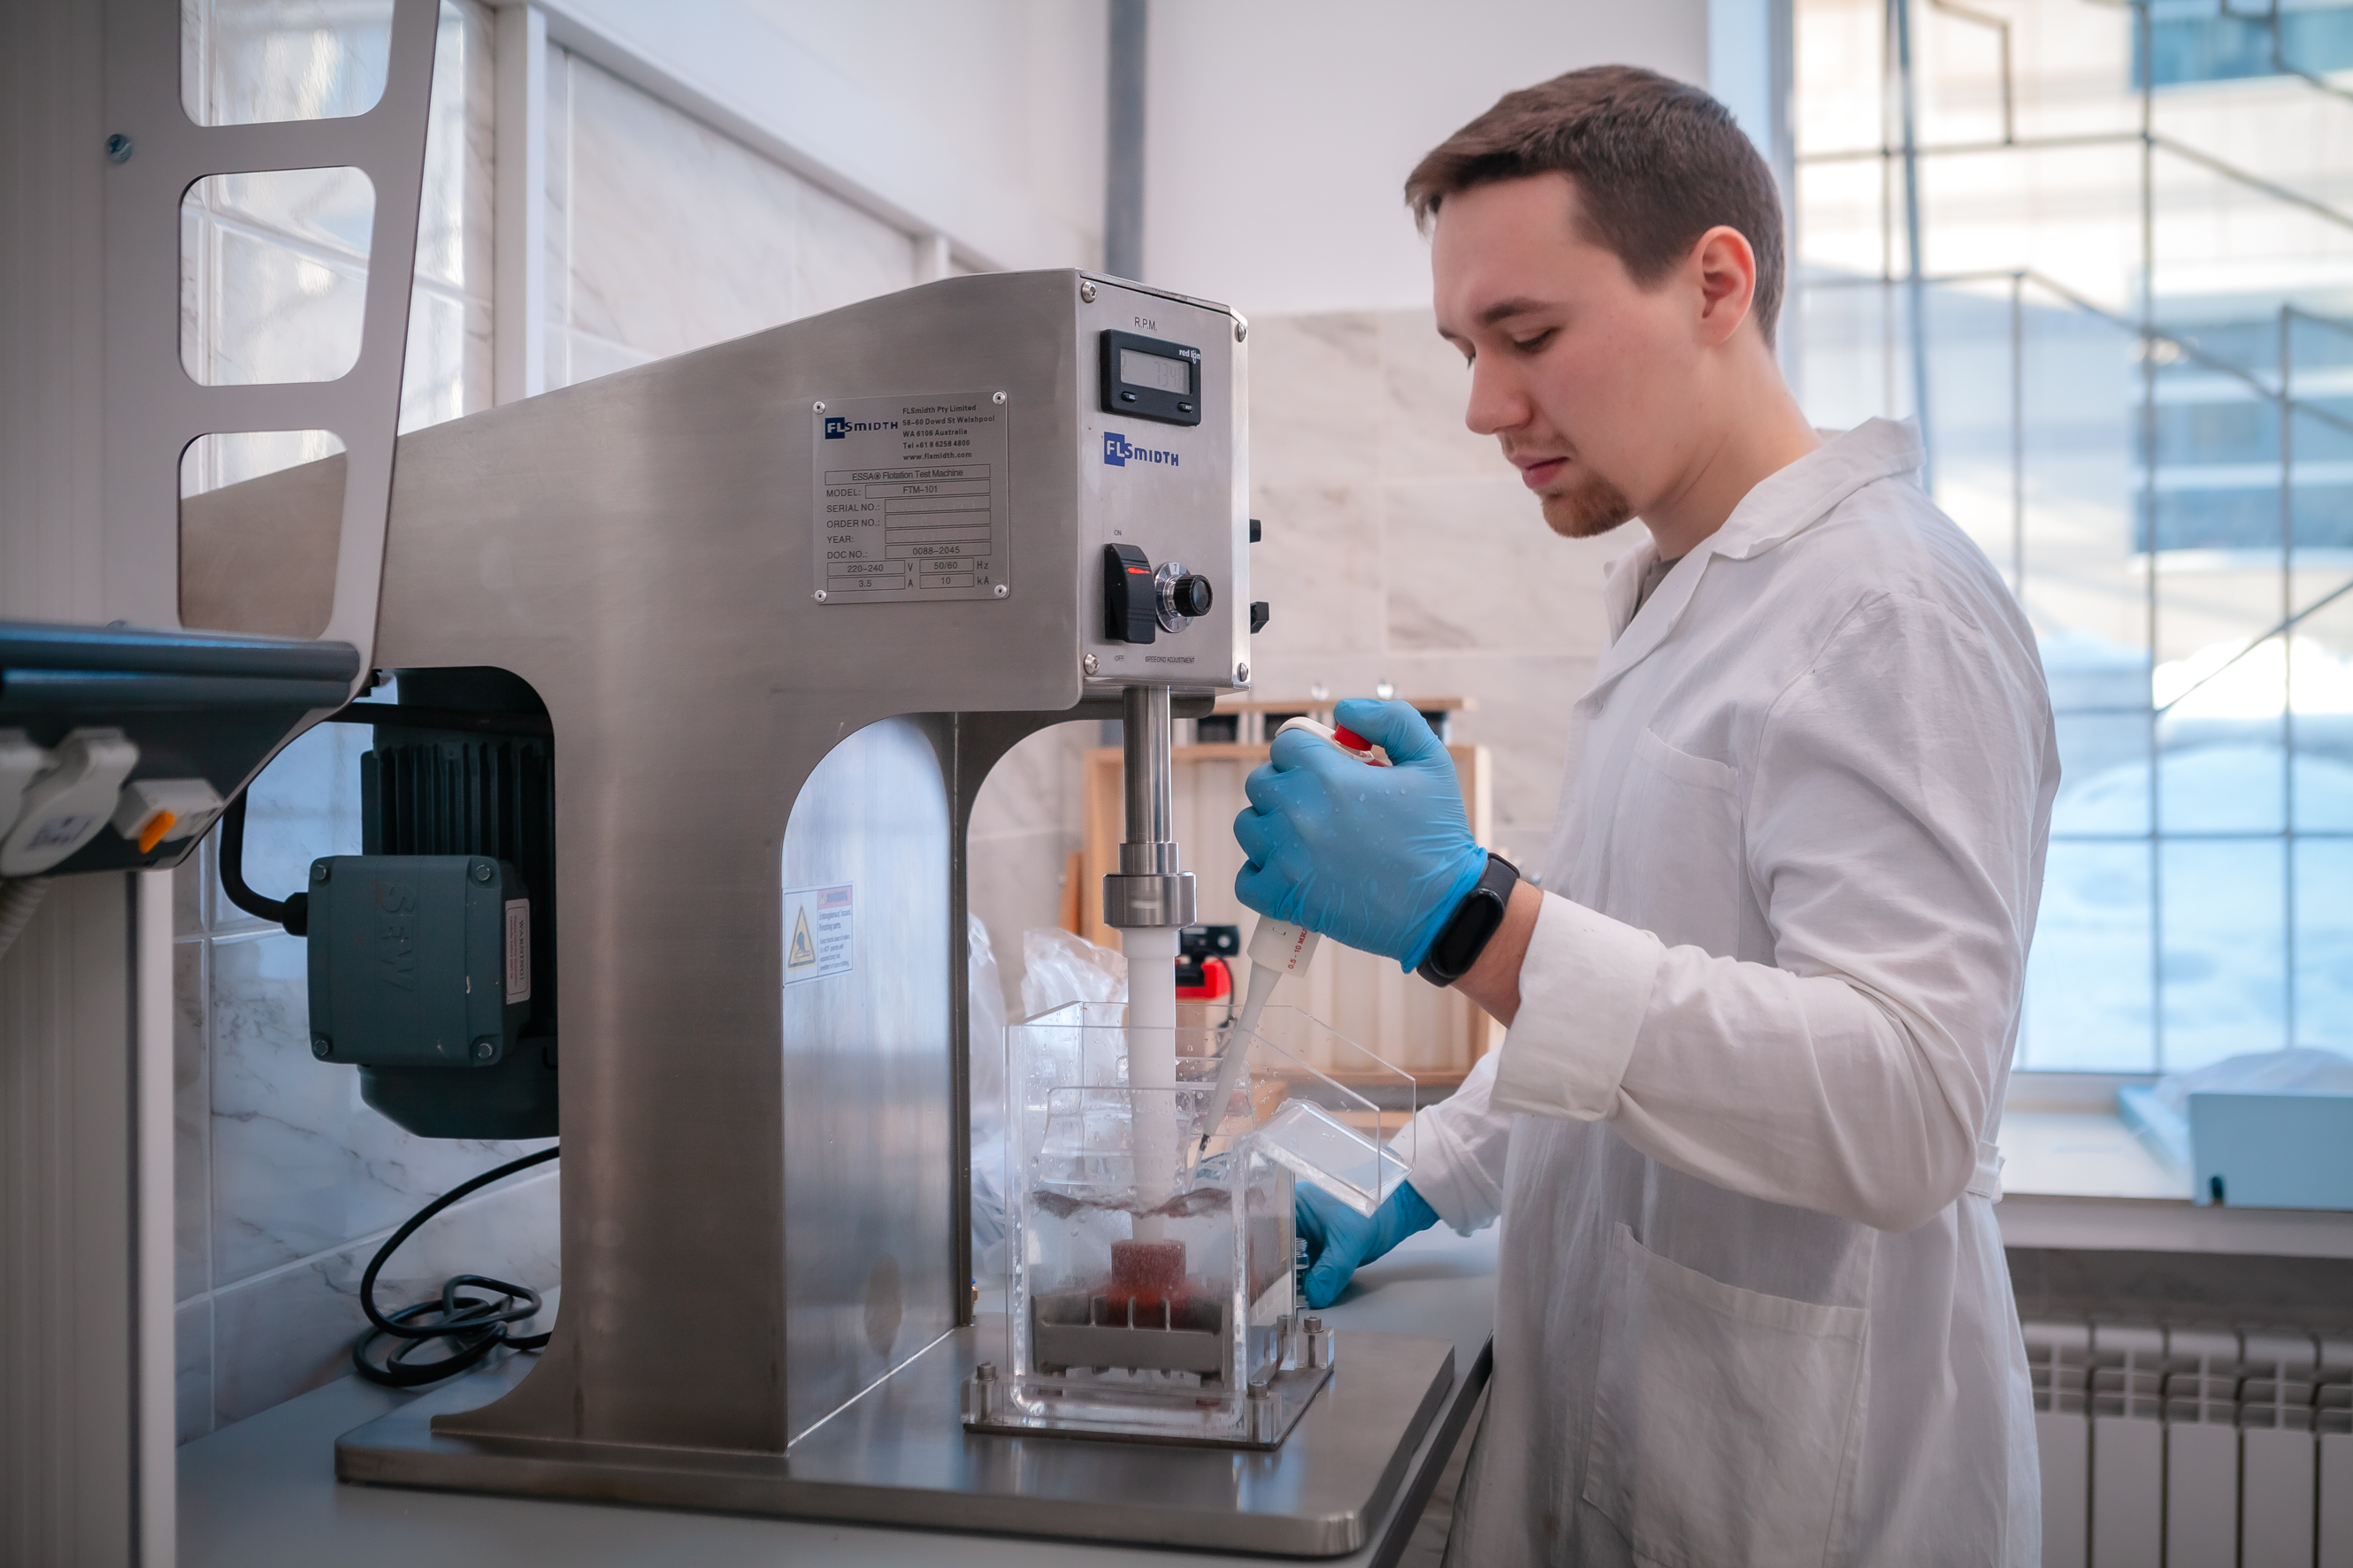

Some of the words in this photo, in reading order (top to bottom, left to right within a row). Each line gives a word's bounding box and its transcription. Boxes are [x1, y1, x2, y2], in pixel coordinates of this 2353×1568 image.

[1134, 317, 1157, 332] R.P.M.
[956, 415, 995, 424] Welshpool
[902, 452, 972, 461] www.flsmidth.com
[882, 470, 914, 480] Flotation
[931, 469, 963, 478] Machine
[826, 489, 861, 498] MODEL:
[902, 486, 938, 494] FTM-101
[826, 504, 859, 513] SERIAL
[826, 519, 859, 529] ORDER
[912, 546, 961, 555] 0088-2045
[827, 551, 847, 560] DOC
[847, 564, 884, 573] 220-240
[907, 562, 914, 572] V
[933, 562, 958, 570] 50/60
[977, 560, 989, 570] Hz
[1173, 563, 1178, 572] 7
[858, 579, 872, 588] 3.5
[907, 578, 914, 588] A
[977, 576, 990, 585] kA
